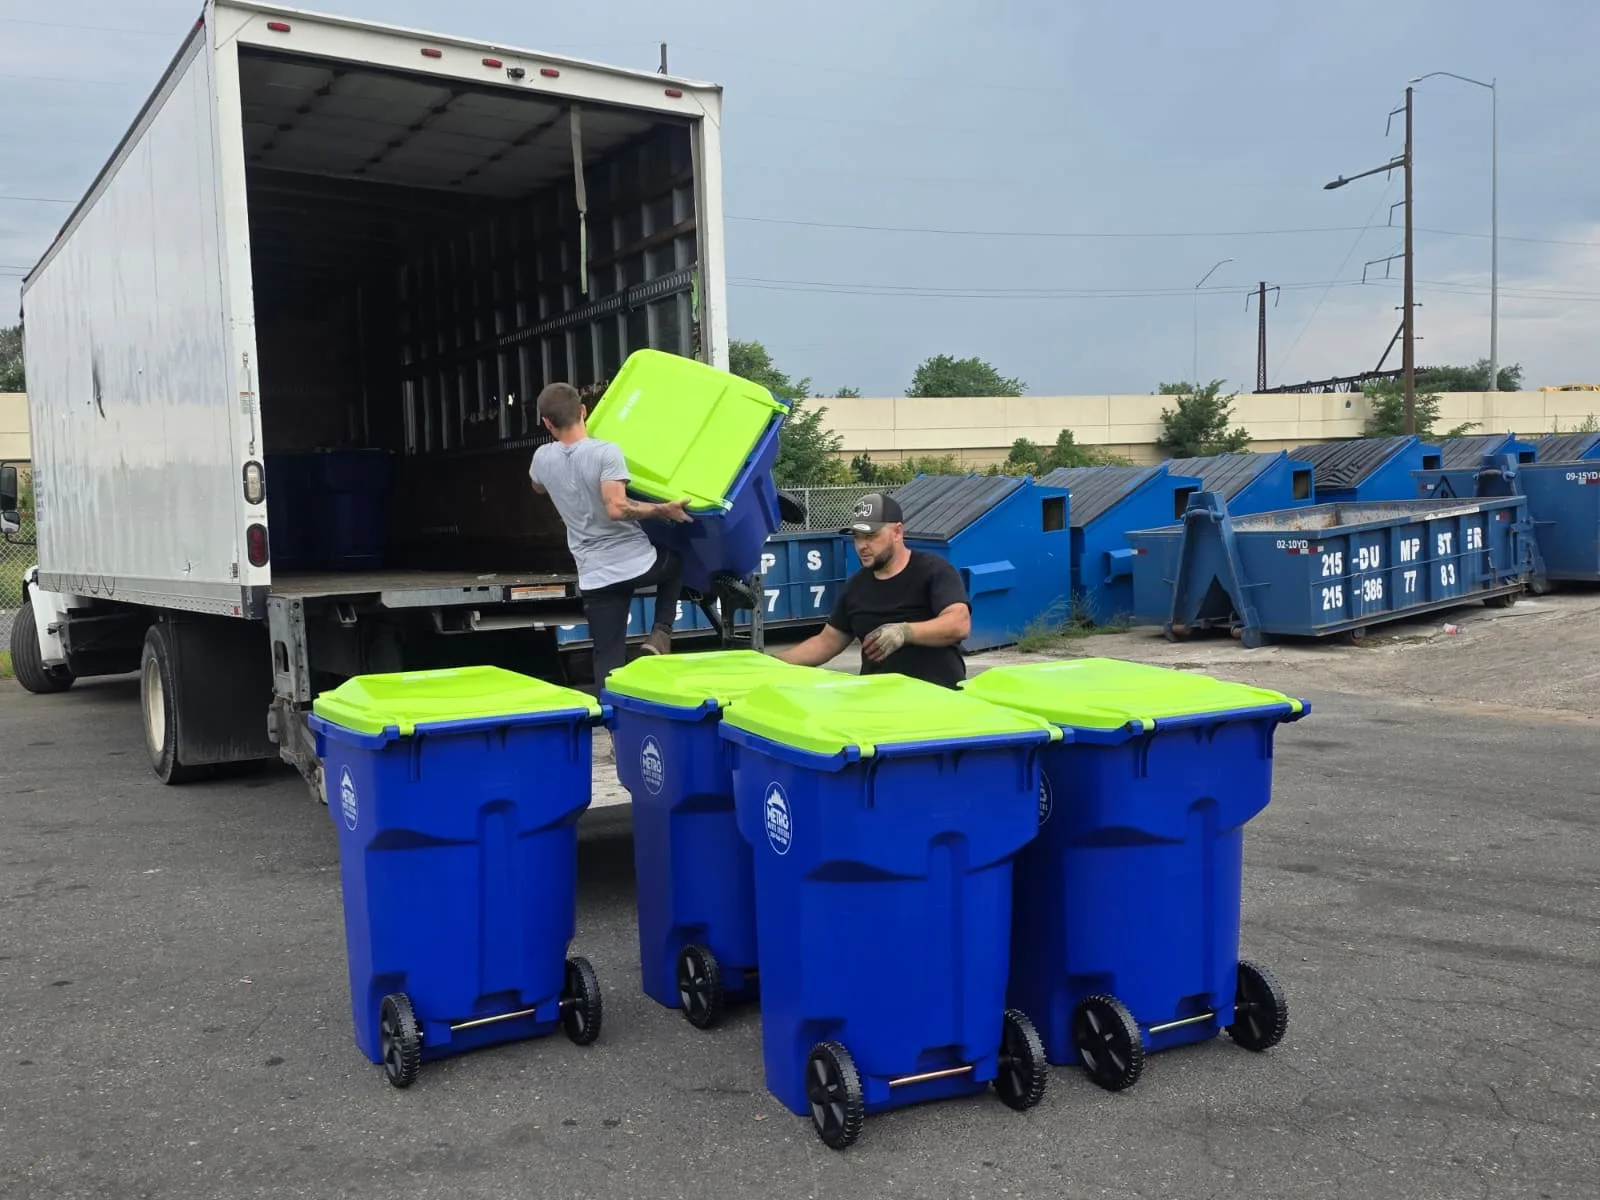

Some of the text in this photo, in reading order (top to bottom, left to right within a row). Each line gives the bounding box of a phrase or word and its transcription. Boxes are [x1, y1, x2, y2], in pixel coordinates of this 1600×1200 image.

[1276, 540, 1309, 549] 02-10YD
[1322, 552, 1343, 576] 215
[1400, 538, 1420, 562] MP
[1437, 532, 1452, 555] ST
[1467, 527, 1482, 549] ER
[760, 550, 822, 574] P S
[763, 585, 826, 612] 7 7
[1322, 585, 1343, 611] 215
[1403, 570, 1417, 593] 77
[1441, 563, 1455, 586] 83
[767, 805, 789, 830] METRO
